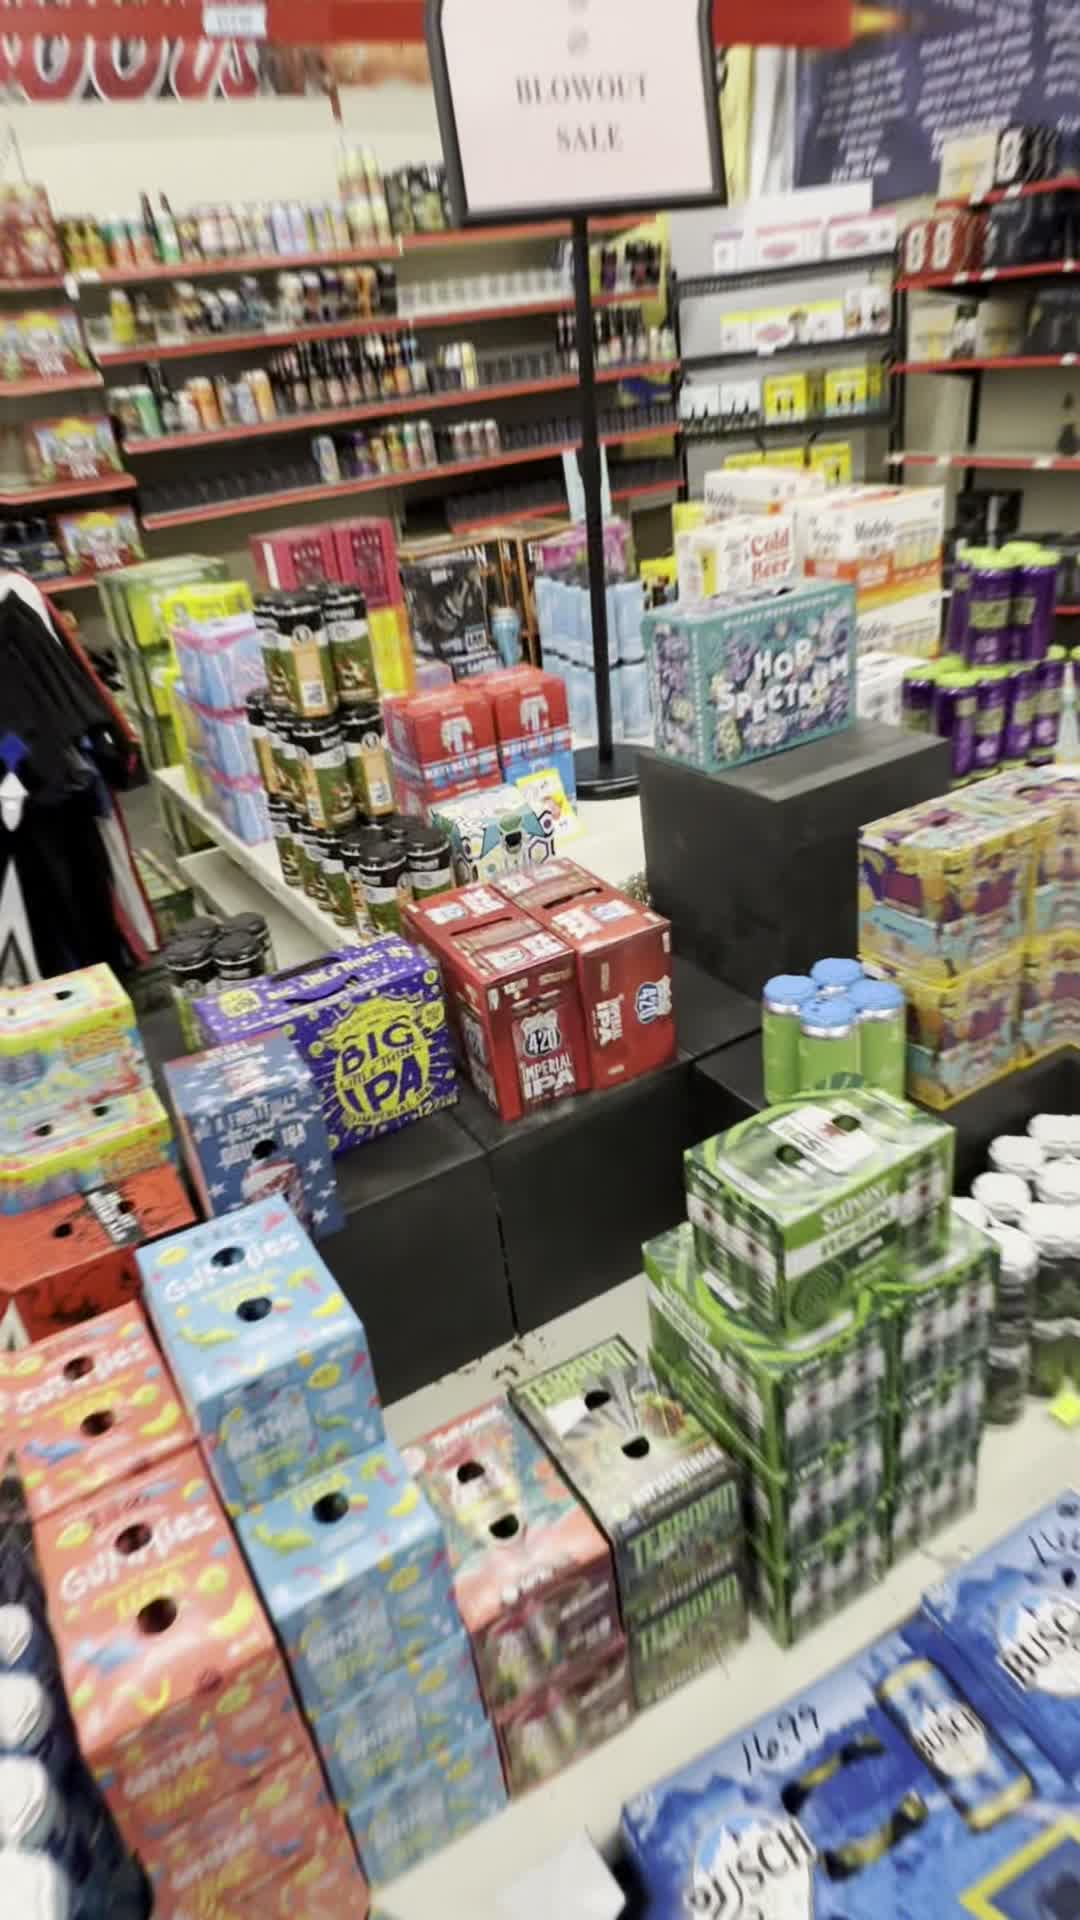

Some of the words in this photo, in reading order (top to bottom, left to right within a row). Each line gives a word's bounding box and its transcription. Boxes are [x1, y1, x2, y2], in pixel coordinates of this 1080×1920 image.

[514, 73, 648, 104] BLOWOUT
[556, 121, 624, 151] SALE
[751, 527, 790, 556] Cold
[751, 557, 790, 583] Beer
[754, 639, 815, 680] HOP
[342, 1022, 414, 1076] BIG
[527, 1028, 561, 1056] 420
[519, 1051, 573, 1083] IMPERIAL
[343, 1055, 423, 1116] IPA
[521, 1071, 576, 1102] IPA
[1000, 1606, 1080, 1690] BUSC
